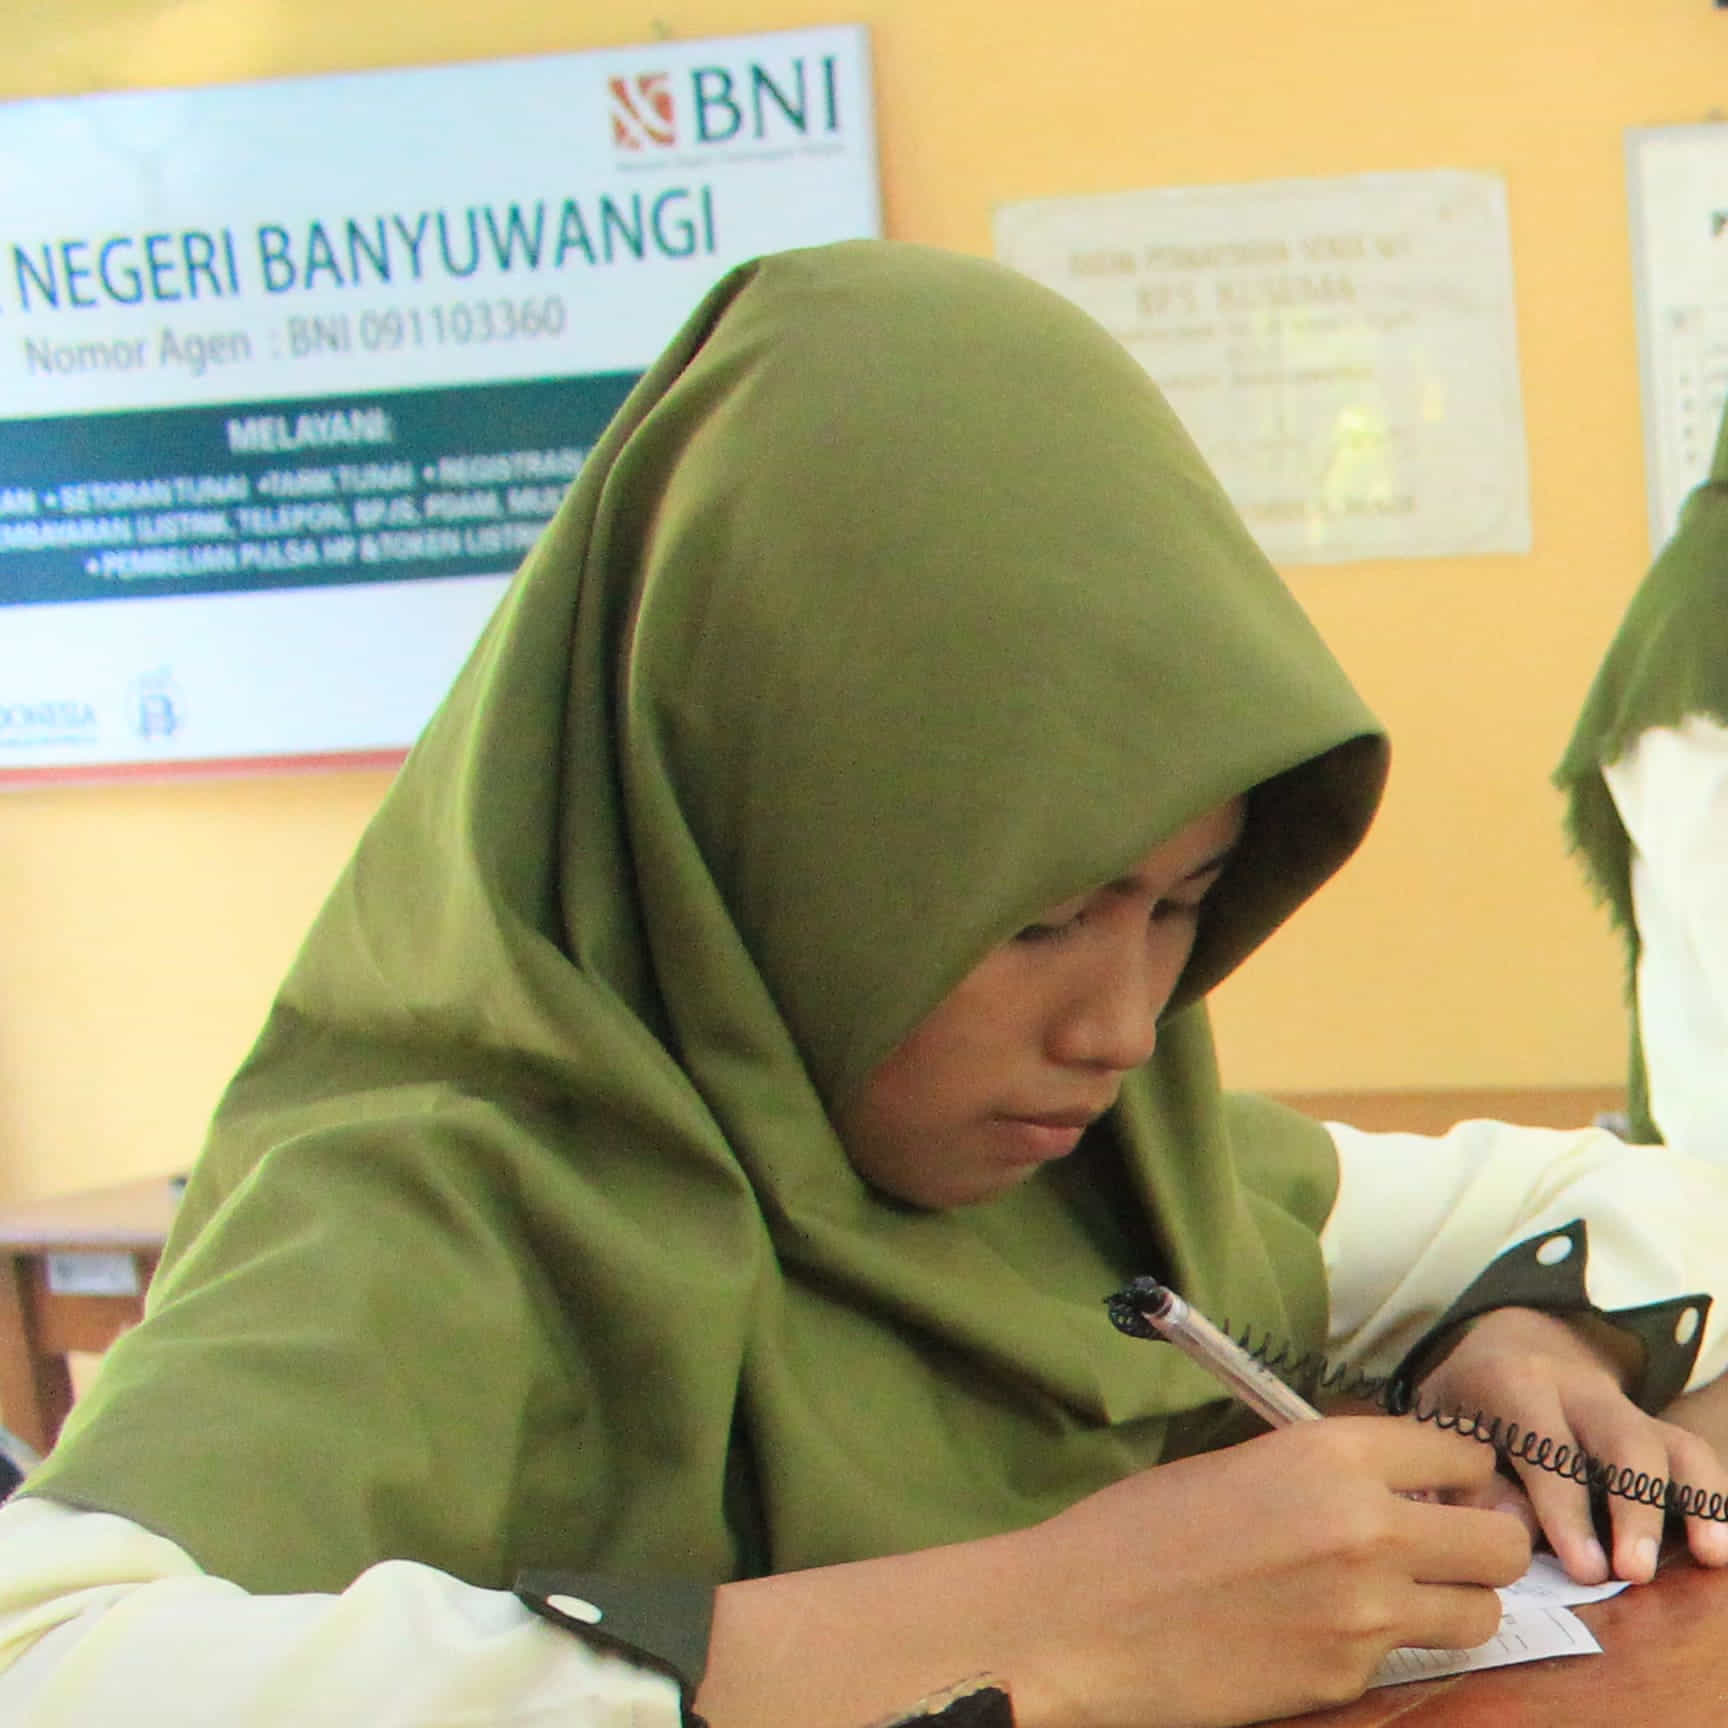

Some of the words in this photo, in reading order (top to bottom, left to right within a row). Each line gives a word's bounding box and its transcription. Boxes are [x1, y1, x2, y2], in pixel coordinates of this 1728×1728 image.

[690, 53, 837, 143] BNI
[11, 225, 240, 312] NEGERI
[257, 185, 717, 294] BANYUWANGI
[25, 335, 146, 376] Nomor
[159, 323, 251, 377] Agen
[287, 313, 354, 357] BNI
[360, 295, 567, 352] 091103360
